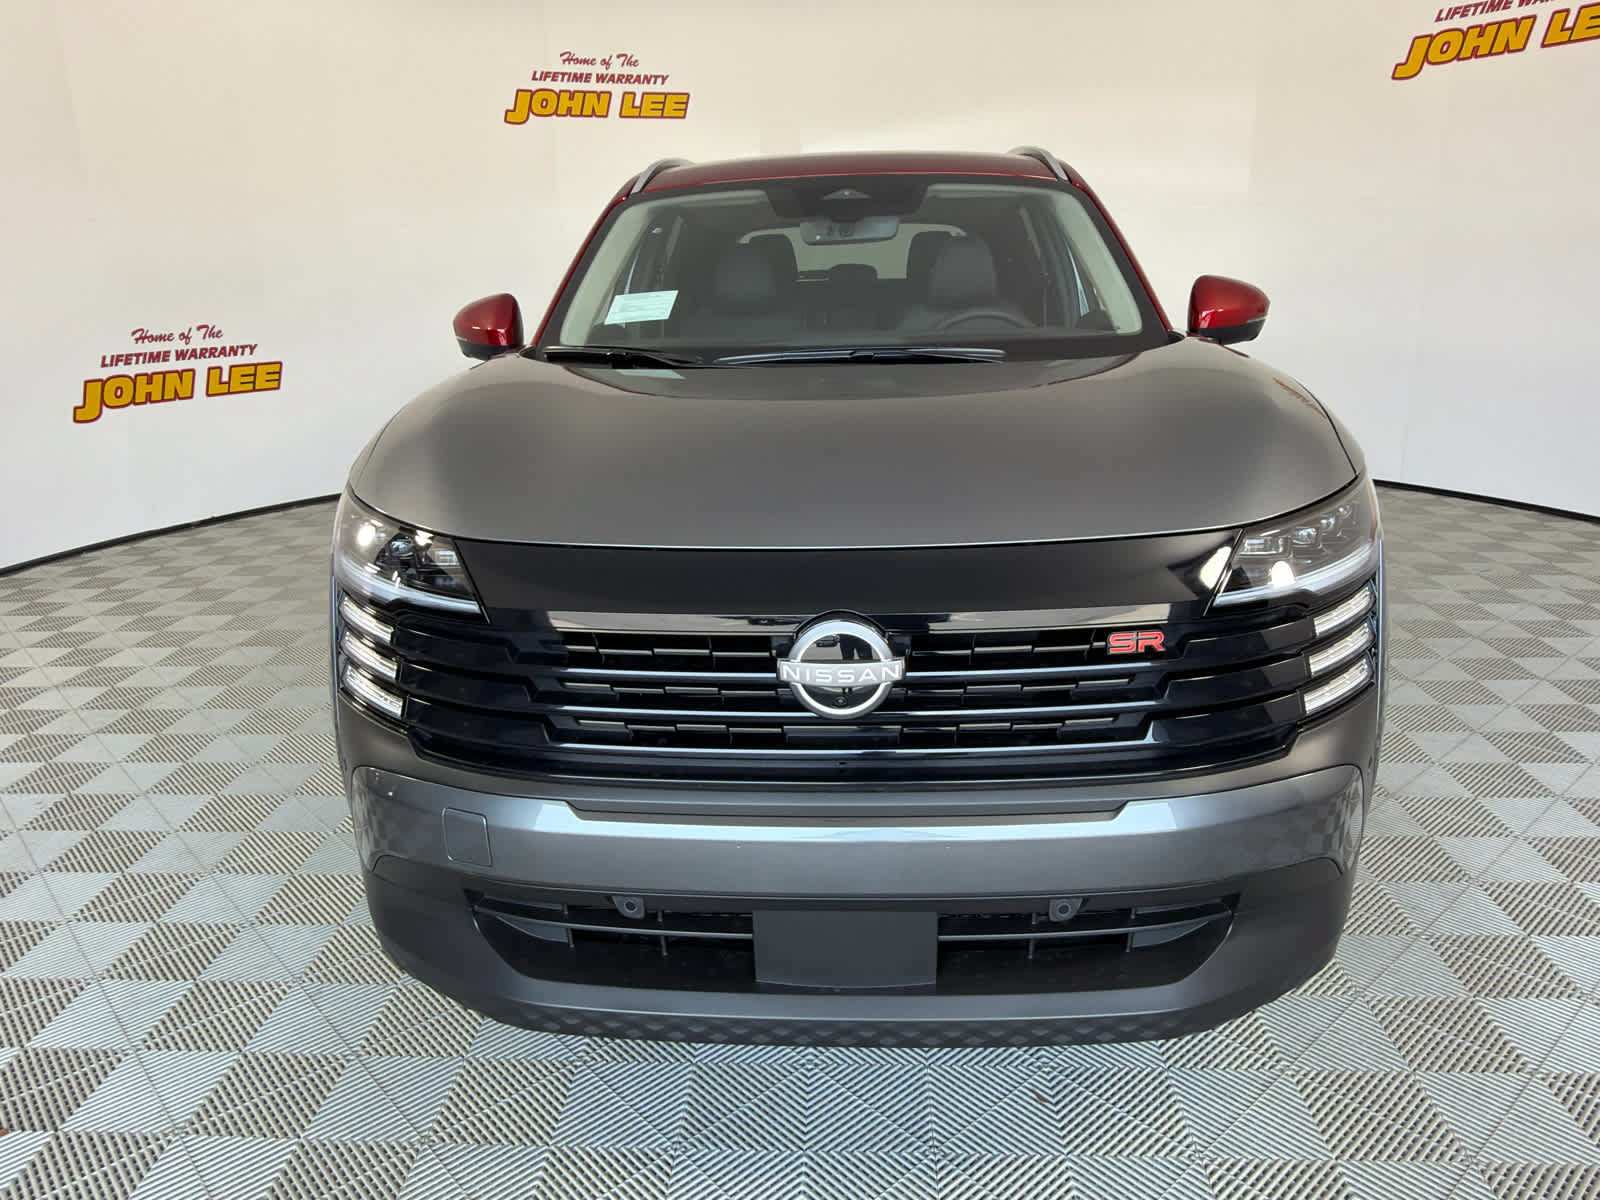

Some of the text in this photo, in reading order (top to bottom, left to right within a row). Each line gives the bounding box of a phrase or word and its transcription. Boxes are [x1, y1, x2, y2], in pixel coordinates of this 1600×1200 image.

[1434, 0, 1513, 22] LIFETIME
[1391, 15, 1537, 80] JOHN
[559, 51, 640, 70] Home of The
[531, 71, 669, 85] LIFETIME WARRANTY
[504, 88, 690, 125] JOHN LEE
[131, 324, 223, 345] Home of The
[100, 344, 258, 368] LIFETIME WARRANTY
[73, 361, 283, 423] JOHN LEE
[1108, 631, 1166, 654] SR
[782, 664, 899, 683] NISSAN
